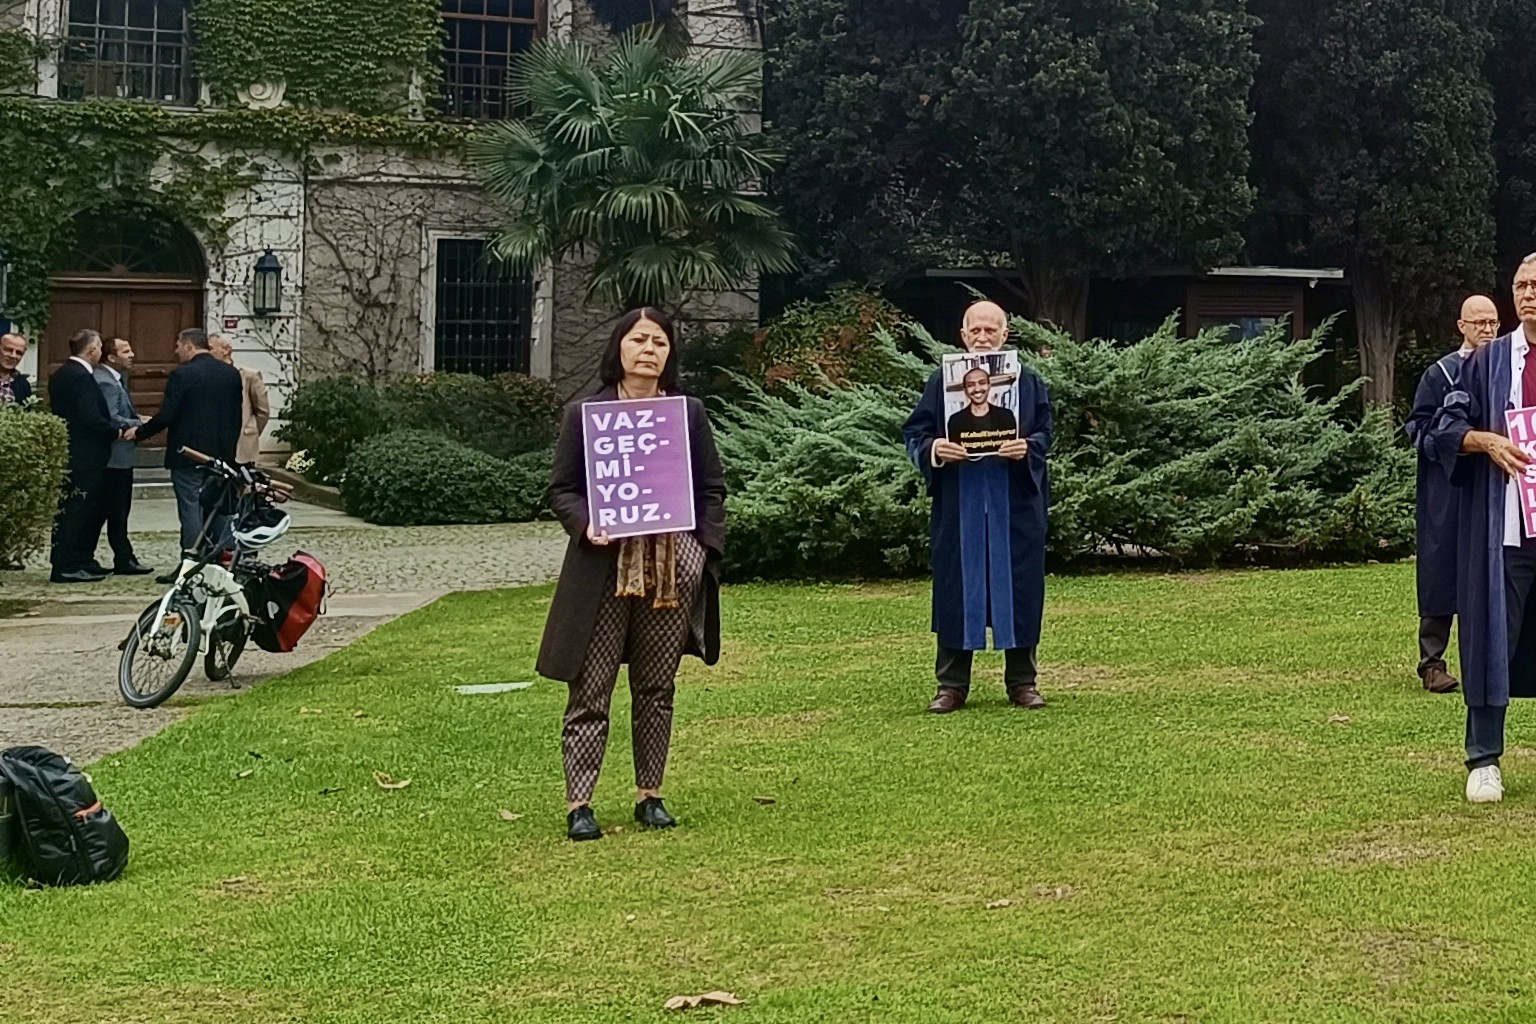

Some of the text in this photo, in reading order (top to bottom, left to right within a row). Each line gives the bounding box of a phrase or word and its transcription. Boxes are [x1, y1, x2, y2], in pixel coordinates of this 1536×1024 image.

[591, 410, 666, 431] VAZ-
[594, 433, 670, 454] GEÇ-
[595, 453, 645, 479] Mİ-
[596, 482, 652, 502] YO-
[599, 503, 671, 526] RUZ.
